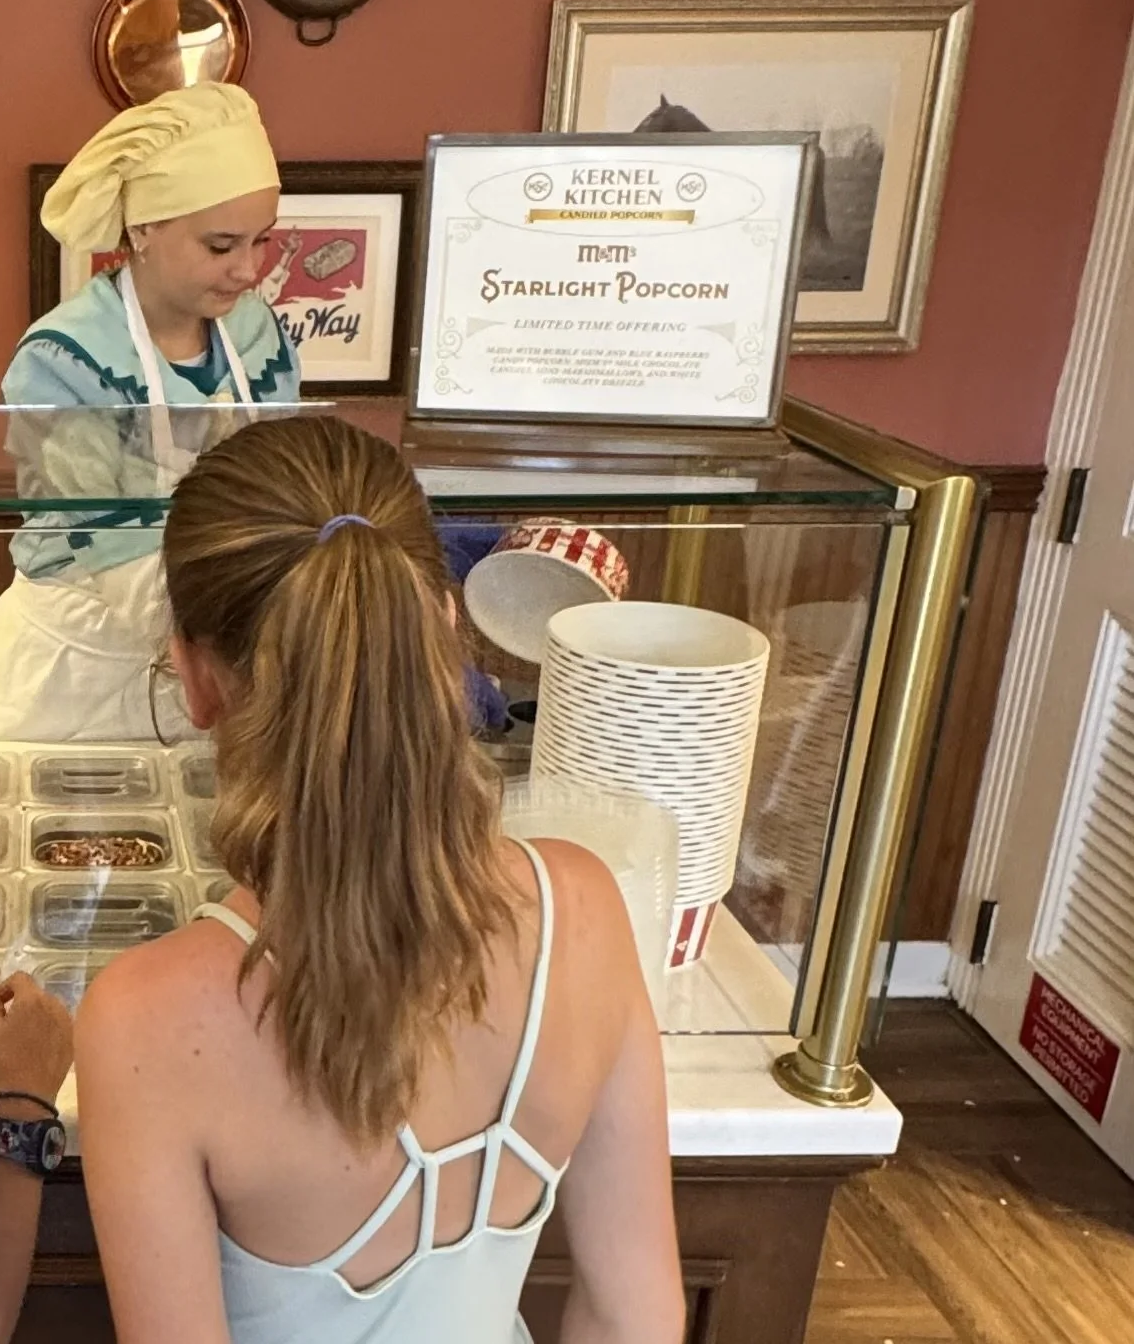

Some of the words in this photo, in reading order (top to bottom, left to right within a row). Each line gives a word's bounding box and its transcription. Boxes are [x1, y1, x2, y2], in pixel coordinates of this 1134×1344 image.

[570, 168, 660, 186] KERNEL
[564, 188, 664, 206] KITCHEN
[559, 210, 607, 220] CANDIED
[610, 210, 664, 220] POPCORN
[480, 268, 612, 304] STARLIGHT
[615, 271, 730, 304] POPCORN
[305, 305, 361, 344] Way
[513, 318, 574, 331] LIMITED
[577, 320, 613, 332] TIME
[616, 321, 687, 334] OFFERING
[1040, 982, 1108, 1056] MECHANICAL
[1040, 1001, 1101, 1065] EQUIPMENT
[1031, 1023, 1050, 1047] NO
[1032, 1041, 1090, 1105] PERMITTED
